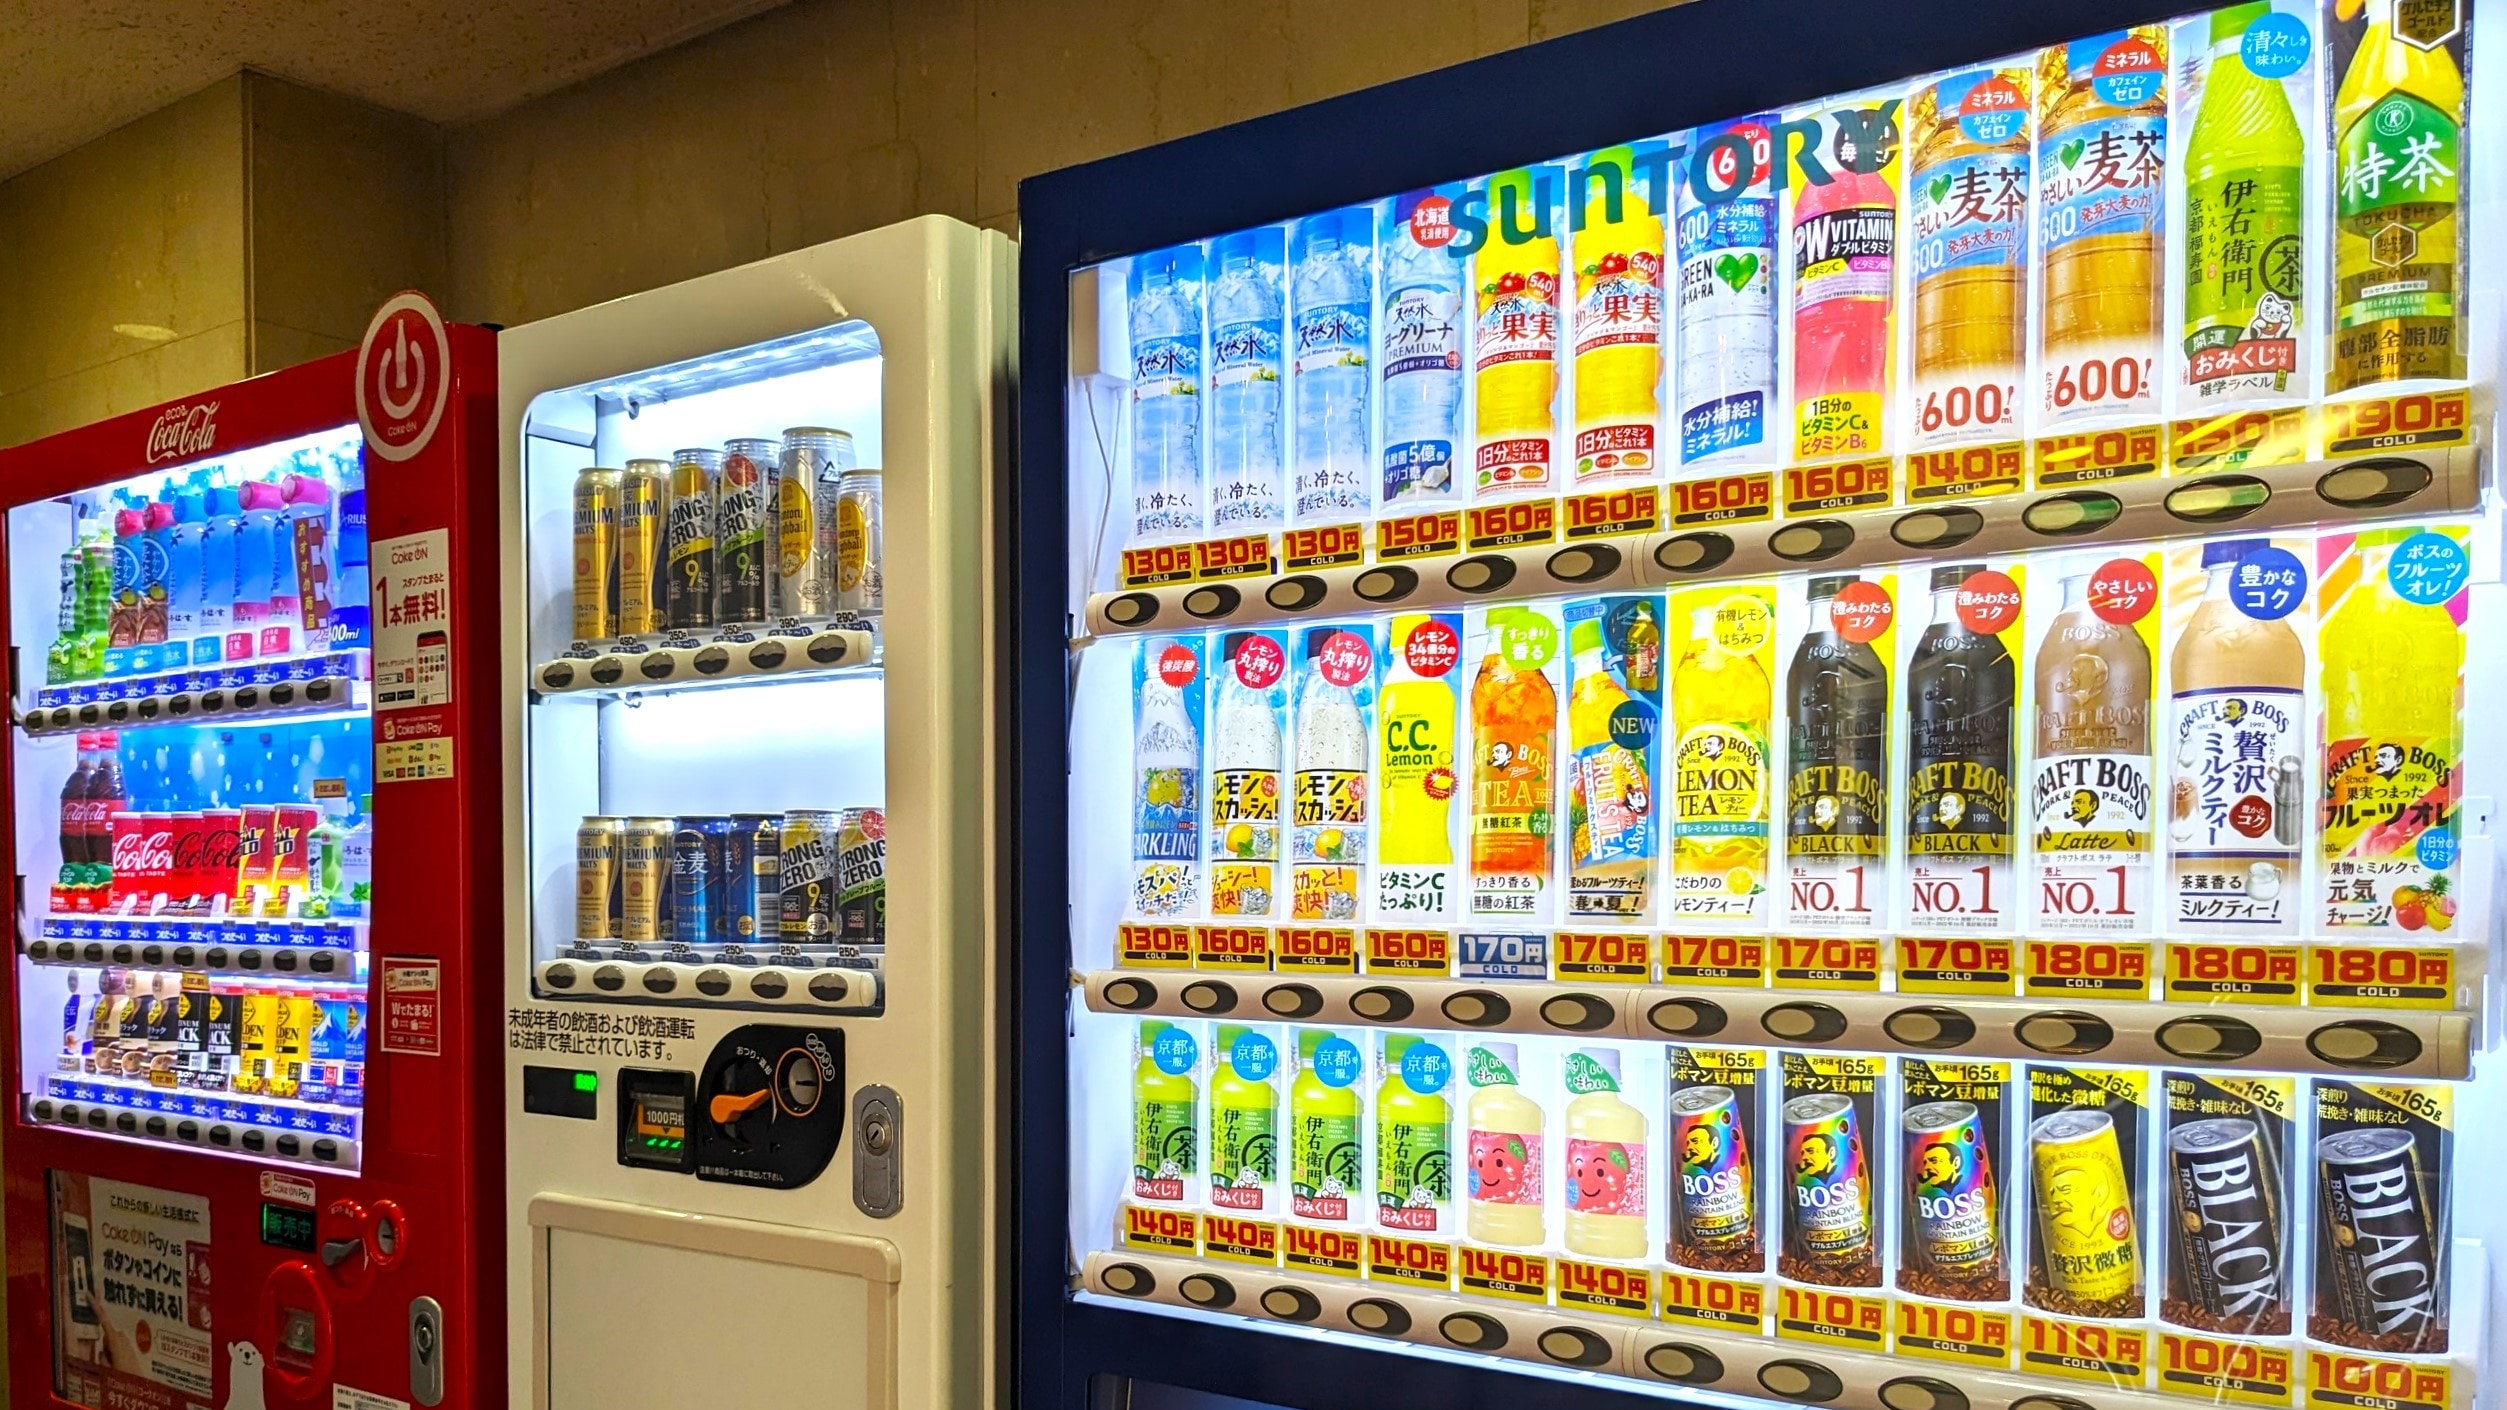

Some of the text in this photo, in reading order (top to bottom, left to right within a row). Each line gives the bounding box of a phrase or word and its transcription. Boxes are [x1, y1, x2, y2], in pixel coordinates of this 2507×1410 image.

[2106, 52, 2150, 68] ミネラル
[1972, 92, 2014, 107] ミネラル
[2114, 86, 2142, 101] ゼロ
[1979, 124, 2006, 139] ゼロ
[2086, 131, 2165, 195] 麦茶
[2341, 131, 2454, 203] 特茶
[1952, 166, 2027, 228] 麦茶
[1716, 222, 1759, 233] ミネラル
[2221, 179, 2258, 296] 伊右衛門
[2339, 329, 2449, 358] 腹部全脂肪
[2200, 376, 2271, 397] 雑学ラベル
[1910, 448, 2020, 485] 140円
[2077, 468, 2114, 480] COLD
[1674, 477, 1768, 512] 160円
[1470, 504, 1551, 536] 160円
[1567, 494, 1654, 526] 160円
[1705, 510, 1735, 520] COLD
[1196, 540, 1266, 566] 130円
[1286, 528, 1359, 558] 130円
[1405, 544, 1430, 554] COLD
[2407, 546, 2453, 559] ボスの
[392, 552, 414, 566] Coke
[1124, 548, 1190, 575] 130円
[297, 523, 315, 629] おすすめ商品
[403, 573, 444, 589] スタンプたまると
[685, 560, 699, 587] 9
[1148, 574, 1169, 582] COLD
[2240, 565, 2295, 586] 豊かな
[2394, 562, 2461, 580] フルーツ
[2093, 580, 2152, 594] やさしい
[2406, 580, 2450, 597] オレ!
[376, 576, 446, 628] 1本無料!
[1833, 601, 1891, 616] 澄みわたる
[1958, 591, 2019, 606] 澄みわたる
[2247, 590, 2288, 610] コク
[1716, 609, 1766, 622] 有機レモン
[1850, 615, 1874, 628] コク
[1976, 606, 2002, 619] コク
[1415, 632, 1449, 642] レモン
[1509, 625, 1548, 640] すっきり
[1719, 632, 1763, 645] はちみつ
[1409, 644, 1455, 655] 34個分の
[1512, 643, 1545, 660] 香る
[1410, 656, 1451, 667] ビタミンC
[428, 722, 442, 735] Pay
[1612, 717, 1654, 733] NEW
[2180, 701, 2289, 737] CRAFT BOSS
[1388, 720, 1437, 751] C.C.
[1386, 752, 1433, 766] Lemon
[2233, 730, 2267, 793] 贅沢
[1677, 769, 1755, 791] LEMON
[2201, 733, 2230, 845] ミルクティー
[1479, 782, 1534, 807] TEA
[2347, 786, 2423, 800] 果実つまった
[1679, 795, 1718, 816] TEA
[1802, 837, 1853, 852] BLACK
[1925, 834, 1980, 851] BLACK
[2054, 833, 2117, 849] Latte
[673, 852, 708, 874] 金麦
[2331, 861, 2419, 874] 果物とミルクで
[781, 862, 816, 889] ZERO
[844, 861, 882, 888] ZERO
[1380, 872, 1444, 889] ビタミンC
[1476, 876, 1530, 888] すっきり香る
[2181, 876, 2241, 889] 茶葉香る
[807, 883, 820, 907] 9
[2329, 879, 2376, 900] 元気
[1380, 893, 1442, 912] たっぷり!
[1474, 895, 1535, 910] 無糖の紅茶
[1675, 897, 1753, 914] レモンティー!
[2181, 900, 2279, 919] ミルクティー!
[2327, 906, 2389, 925] チャージ!
[1122, 927, 1188, 952] 130円
[1278, 930, 1350, 957] 160円
[1369, 932, 1444, 960] 160円
[1464, 935, 1542, 963] 170円
[1219, 954, 1242, 963] COLD
[1668, 937, 1761, 967] 170円
[1776, 938, 1876, 969] 170円
[1901, 939, 2009, 971] 170円
[2172, 946, 2296, 980] 180円
[1483, 964, 1518, 974] COLD
[1936, 971, 1971, 981] COLD
[2316, 949, 2447, 985] 180円
[2356, 986, 2399, 997] COLD
[509, 1009, 695, 1039] 未成年者の飲酒および飲酒運転
[509, 1032, 672, 1060] は法律で禁止されています。
[2031, 1087, 2105, 1106] 進化した微糖
[2168, 1079, 2195, 1094] 深煎り
[1146, 1102, 1162, 1169] 伊右衛門
[1224, 1108, 1241, 1177] 伊右衛門
[1307, 1116, 1325, 1186] 伊右衛門
[1393, 1123, 1413, 1196] 伊右衛門
[1682, 1166, 1741, 1195] BOSS
[2180, 1168, 2196, 1208] BOSS
[1797, 1177, 1859, 1207] BOSS
[1918, 1187, 1985, 1218] BOSS
[2331, 1179, 2348, 1221] BOSS
[1128, 1208, 1193, 1237] 140円
[102, 1222, 128, 1242] Coke
[148, 1232, 168, 1257] Pay
[1286, 1227, 1358, 1261] 140円
[2192, 1152, 2278, 1318] BLACK
[1370, 1238, 1446, 1272] 140円
[2052, 1243, 2133, 1275] 贅沢微糖
[2344, 1163, 2433, 1336] BLACK
[103, 1248, 182, 1288] ボタンやコインに
[1396, 1269, 1420, 1278] COLD
[1463, 1249, 1543, 1284] 140円
[1669, 1276, 1759, 1314] 110円
[1784, 1289, 1882, 1330] 110円
[1814, 1325, 1846, 1336] COLD
[1902, 1304, 2005, 1345] 110円
[2165, 1337, 2286, 1383] 100円
[2203, 1376, 2243, 1389] COLD
[2312, 1354, 2444, 1402] 100円
